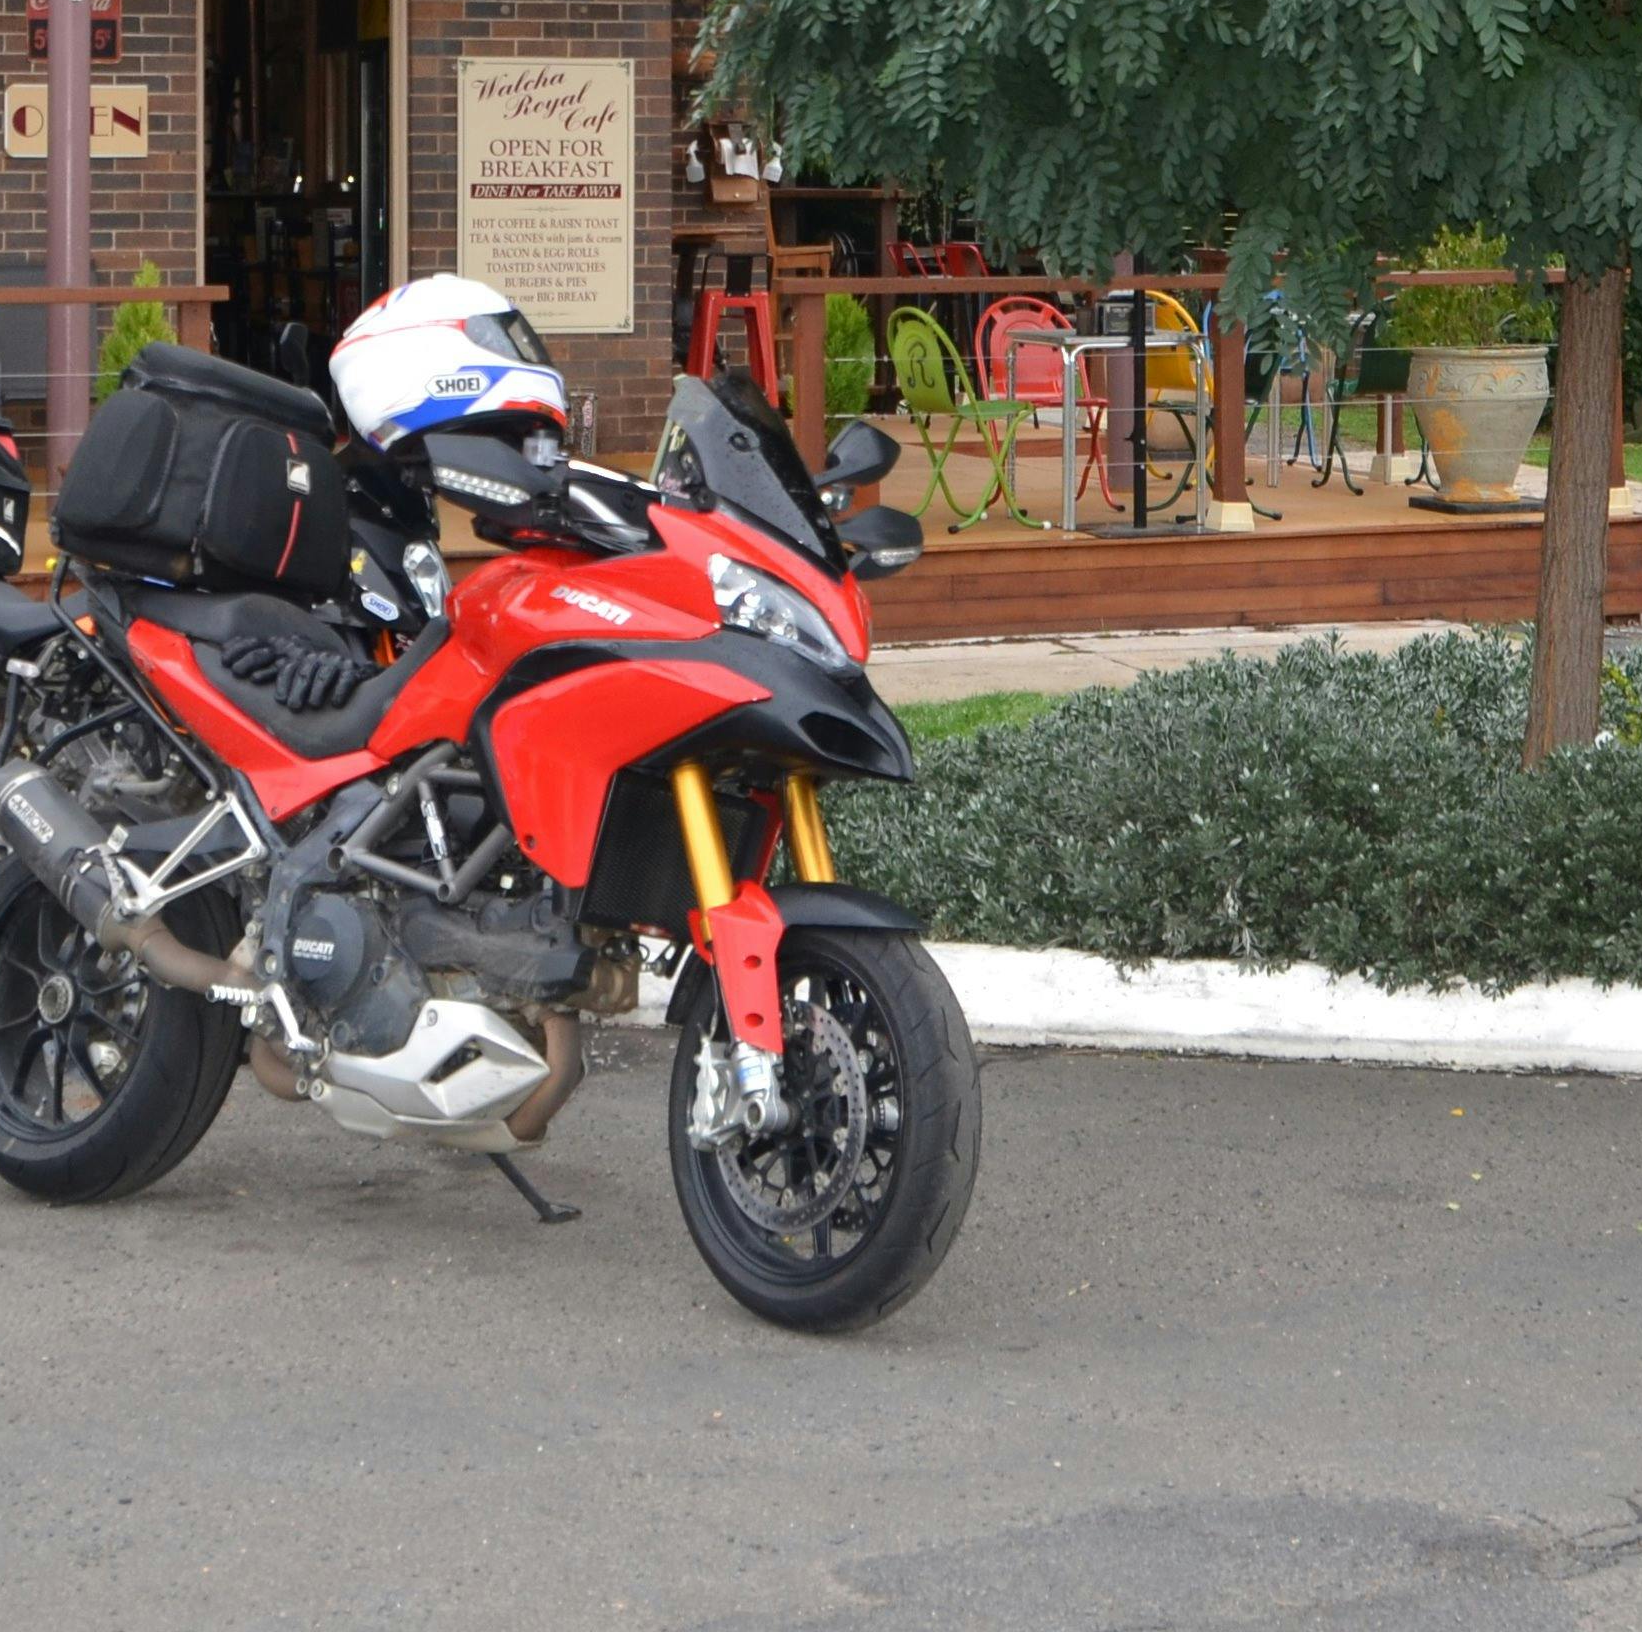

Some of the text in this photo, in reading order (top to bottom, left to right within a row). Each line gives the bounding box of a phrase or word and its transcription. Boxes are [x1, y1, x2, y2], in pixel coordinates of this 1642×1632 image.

[472, 65, 566, 103] Walcha
[503, 80, 593, 120] Royal
[12, 104, 142, 137] OEN
[489, 139, 604, 157] OPEN FOR
[480, 160, 614, 179] BREAKFAST
[474, 185, 619, 198] DINE IN or TAKE AWAY
[472, 218, 620, 229] HOT COFFEE & RAISIN TOAST
[469, 233, 490, 244] TEA
[492, 233, 501, 244] &
[503, 233, 544, 244] SCONES
[546, 233, 565, 244] with
[585, 233, 595, 243] &
[596, 235, 623, 244] cream
[492, 248, 600, 259] BACON & EGG ROLLS
[486, 262, 606, 274] TOASTED SANDWICHES
[504, 277, 588, 288] BURGERS & PIES
[537, 292, 555, 302] BIG
[557, 292, 599, 303] BREAKY
[434, 376, 481, 394] SHOEI
[549, 583, 634, 626] DUCATI
[10, 797, 52, 839] ARROW
[293, 938, 335, 955] DUCATI
